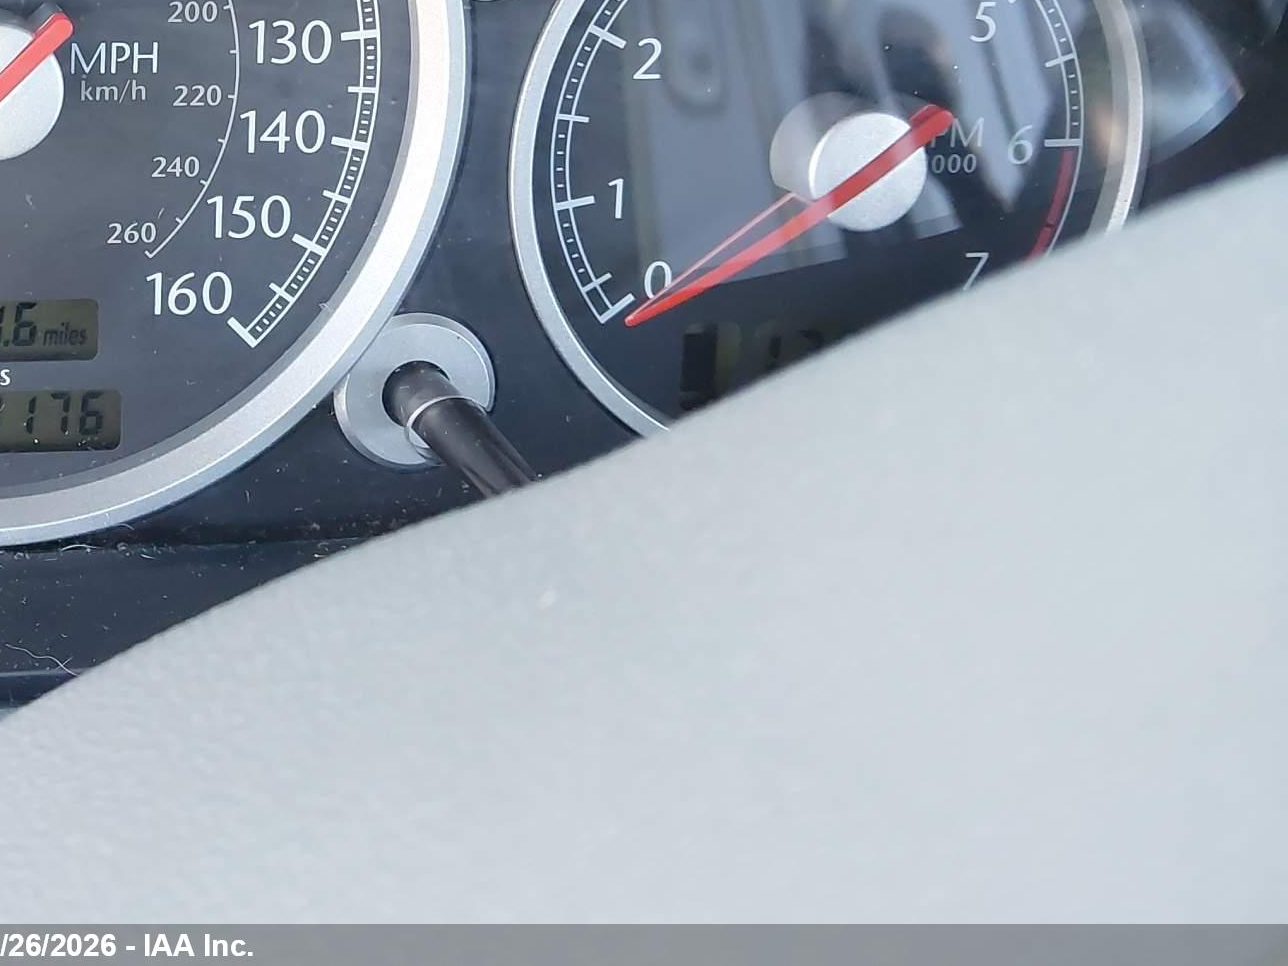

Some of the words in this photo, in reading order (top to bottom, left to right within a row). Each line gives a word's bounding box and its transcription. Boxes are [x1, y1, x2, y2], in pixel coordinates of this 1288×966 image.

[167, 0, 218, 23] 200
[969, 1, 997, 43] 5
[70, 41, 159, 75] MPH
[248, 19, 332, 64] 130
[632, 37, 662, 80] 2
[80, 79, 146, 104] km/h
[172, 84, 222, 107] 220
[239, 110, 326, 154] 140
[1008, 124, 1033, 164] 6
[151, 156, 200, 178] 240
[206, 194, 291, 239] 150
[608, 178, 624, 219] 1
[107, 222, 157, 244] 260
[644, 260, 672, 299] 0
[964, 251, 990, 291] 7
[146, 271, 233, 316] 160
[43, 322, 86, 346] miles
